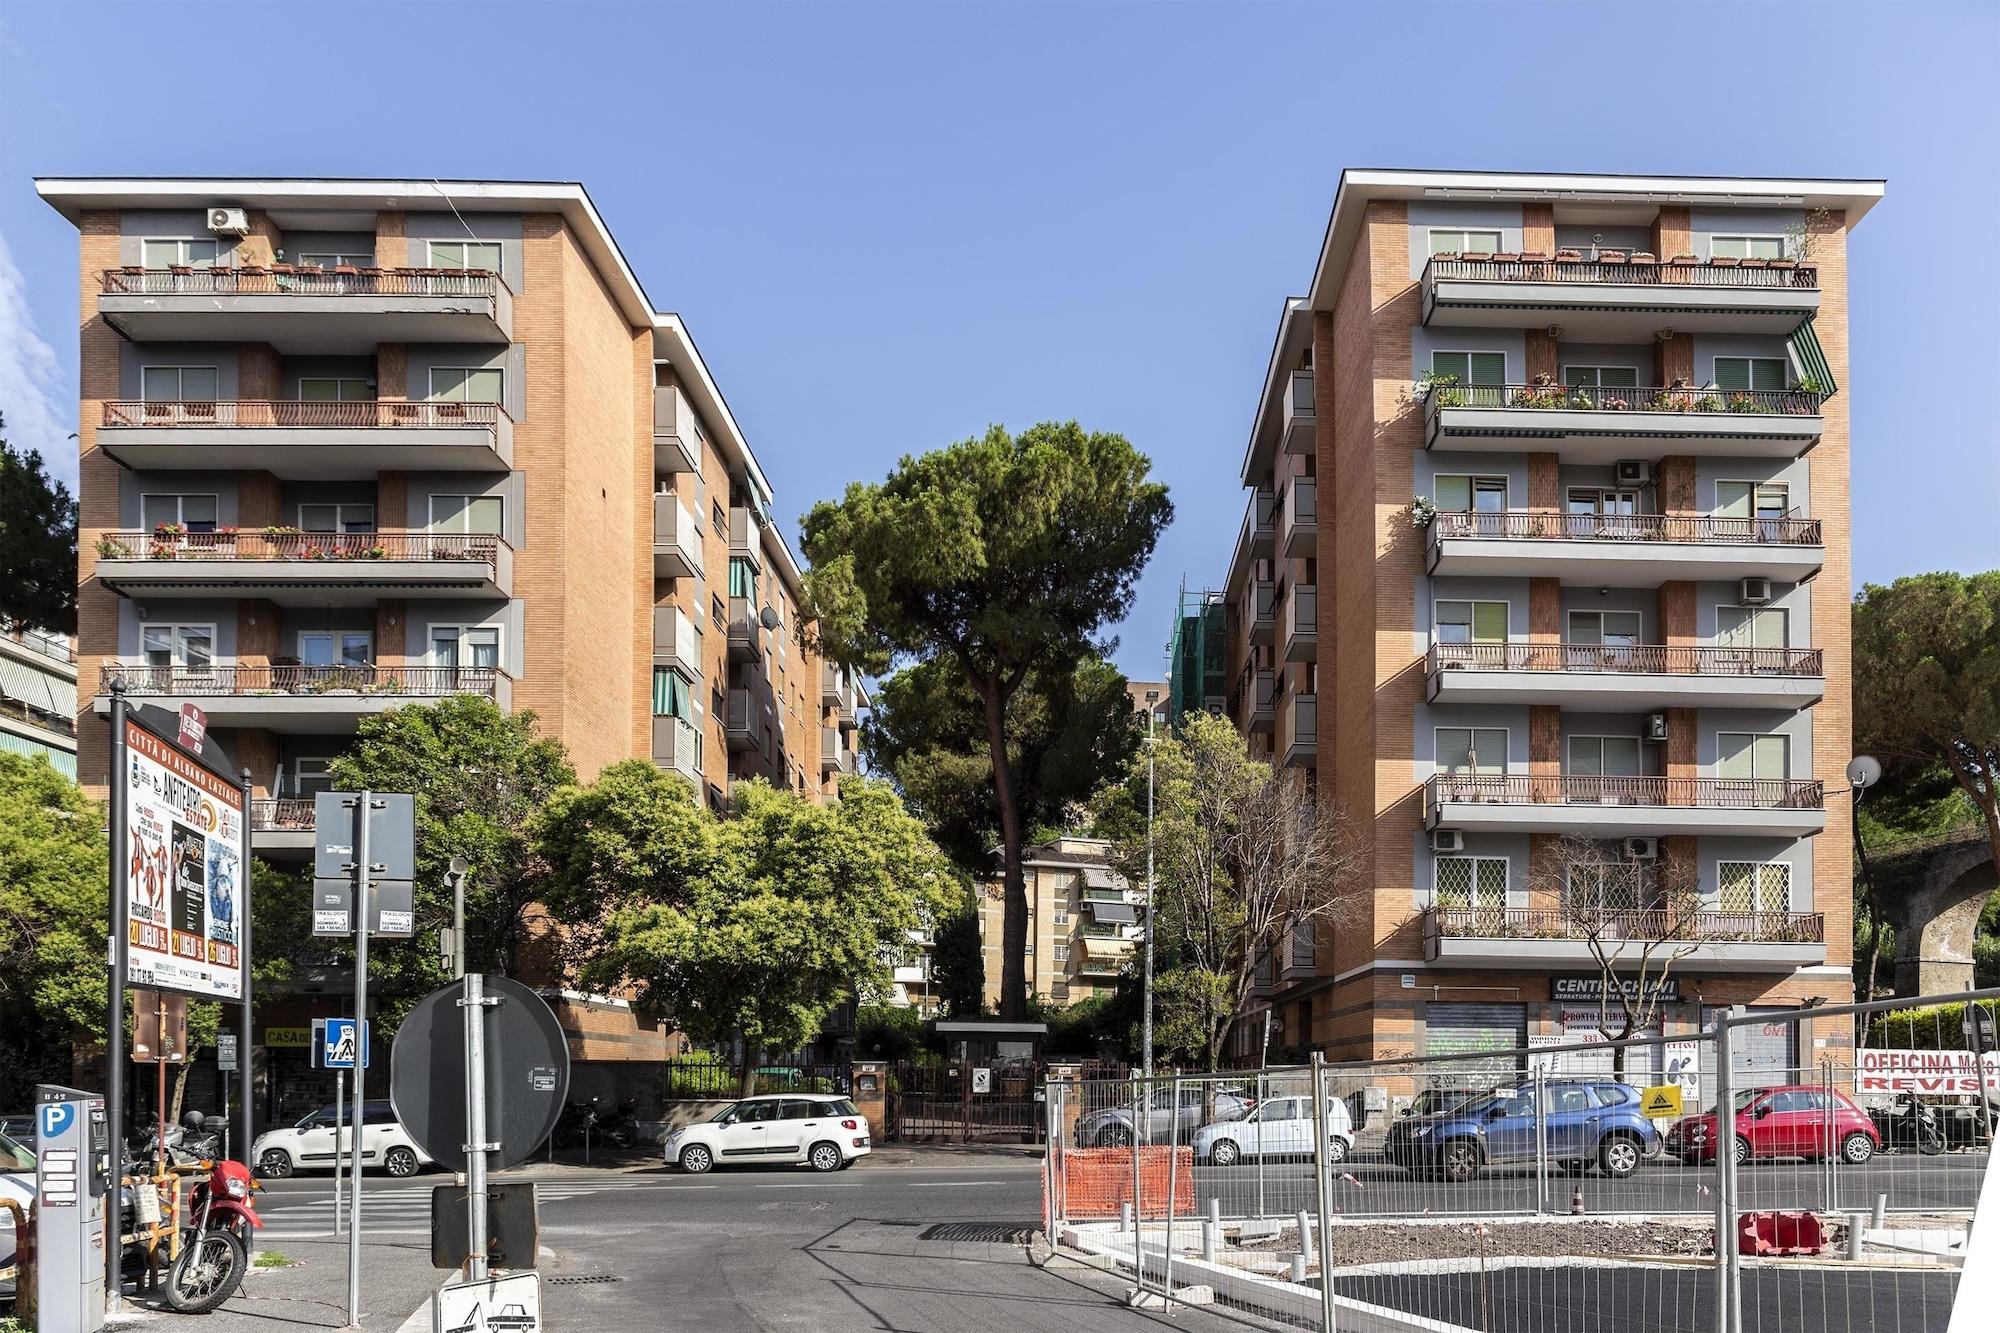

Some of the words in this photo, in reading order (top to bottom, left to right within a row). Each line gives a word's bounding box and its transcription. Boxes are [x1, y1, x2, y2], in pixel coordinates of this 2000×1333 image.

[129, 729, 158, 757] CITTÀ
[161, 748, 171, 764] DI
[174, 757, 206, 786] ALBANO
[208, 778, 239, 806] LAZIALE
[163, 772, 202, 814] ANFITEATRO
[185, 806, 208, 831] ESTATE
[131, 902, 153, 921] RICCARDO
[130, 920, 139, 946] 20
[1565, 1012, 1595, 1021] PRONTO
[268, 1031, 298, 1043] CASA
[1864, 1053, 1953, 1075] OFFICINA
[46, 1107, 66, 1132] P
